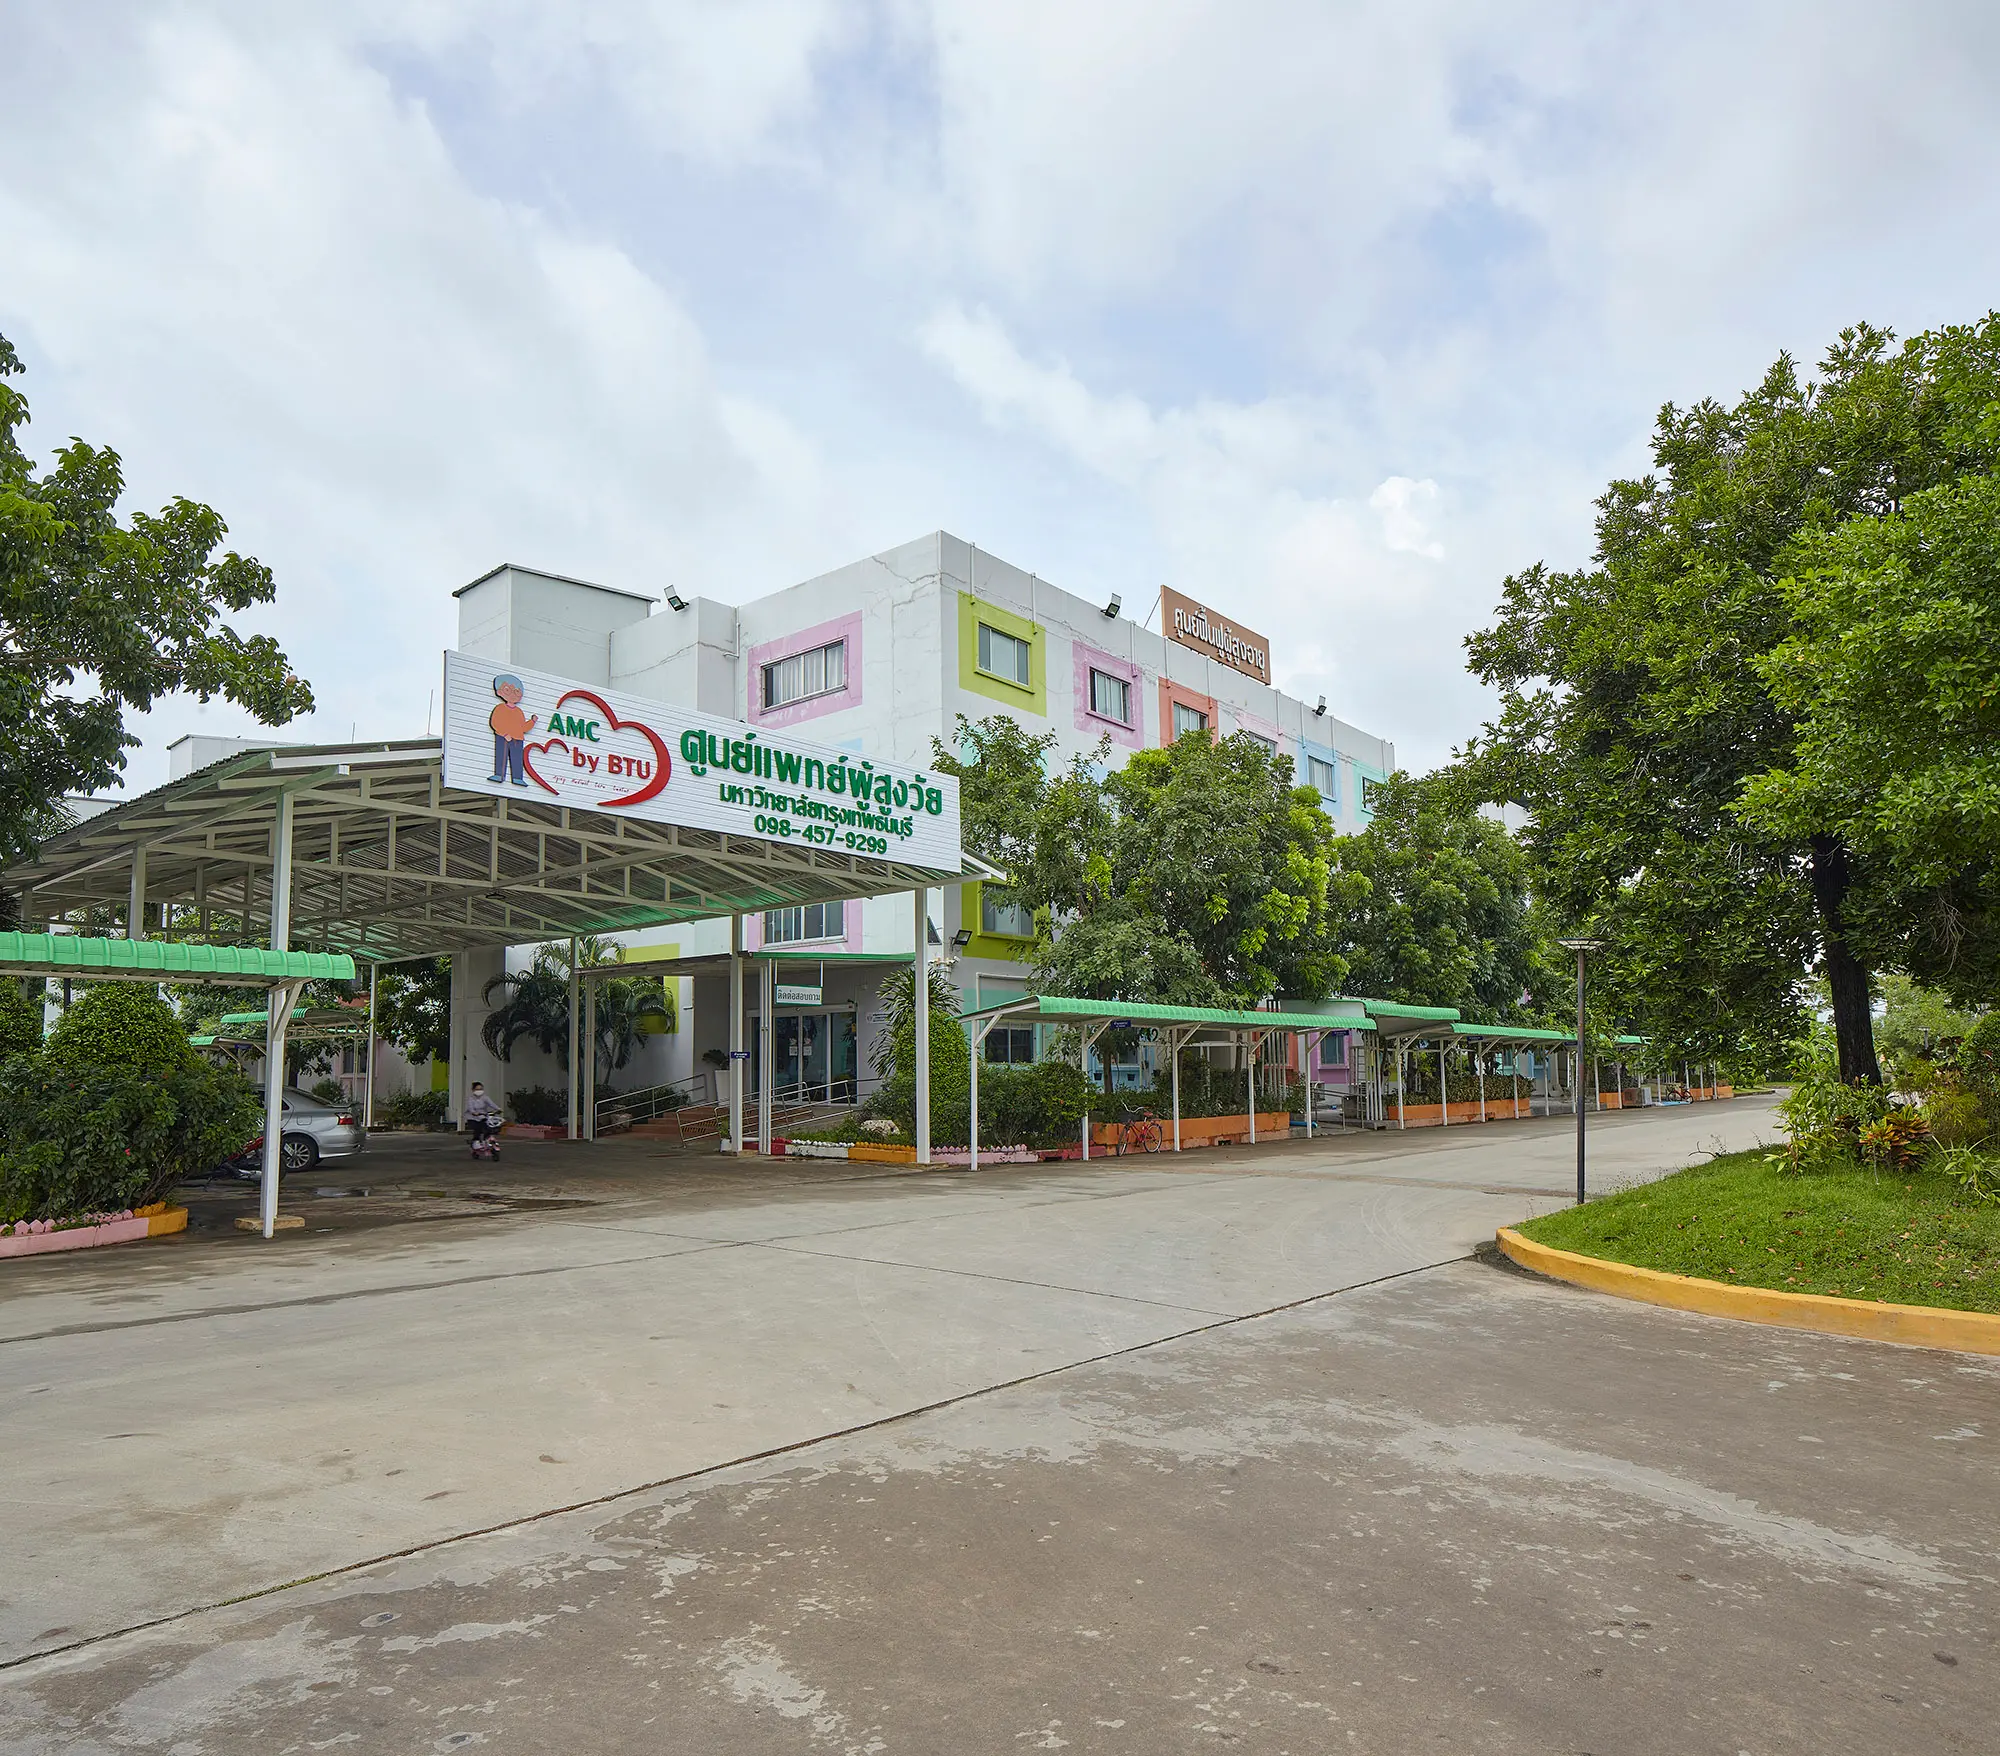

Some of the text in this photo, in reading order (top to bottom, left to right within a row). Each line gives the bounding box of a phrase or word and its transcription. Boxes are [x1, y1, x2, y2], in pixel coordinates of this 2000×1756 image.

[1174, 606, 1265, 678] ศูนย์ฟื้นฟูผู้สูงอายุ
[547, 713, 600, 742] AMC
[572, 747, 650, 779] by BTU
[719, 783, 914, 841] มหาวิทยาลัยกรุงเทพธนบุรี
[754, 814, 887, 854] 098-457-9299
[777, 989, 821, 1001] ติดต่อสอบถาม
